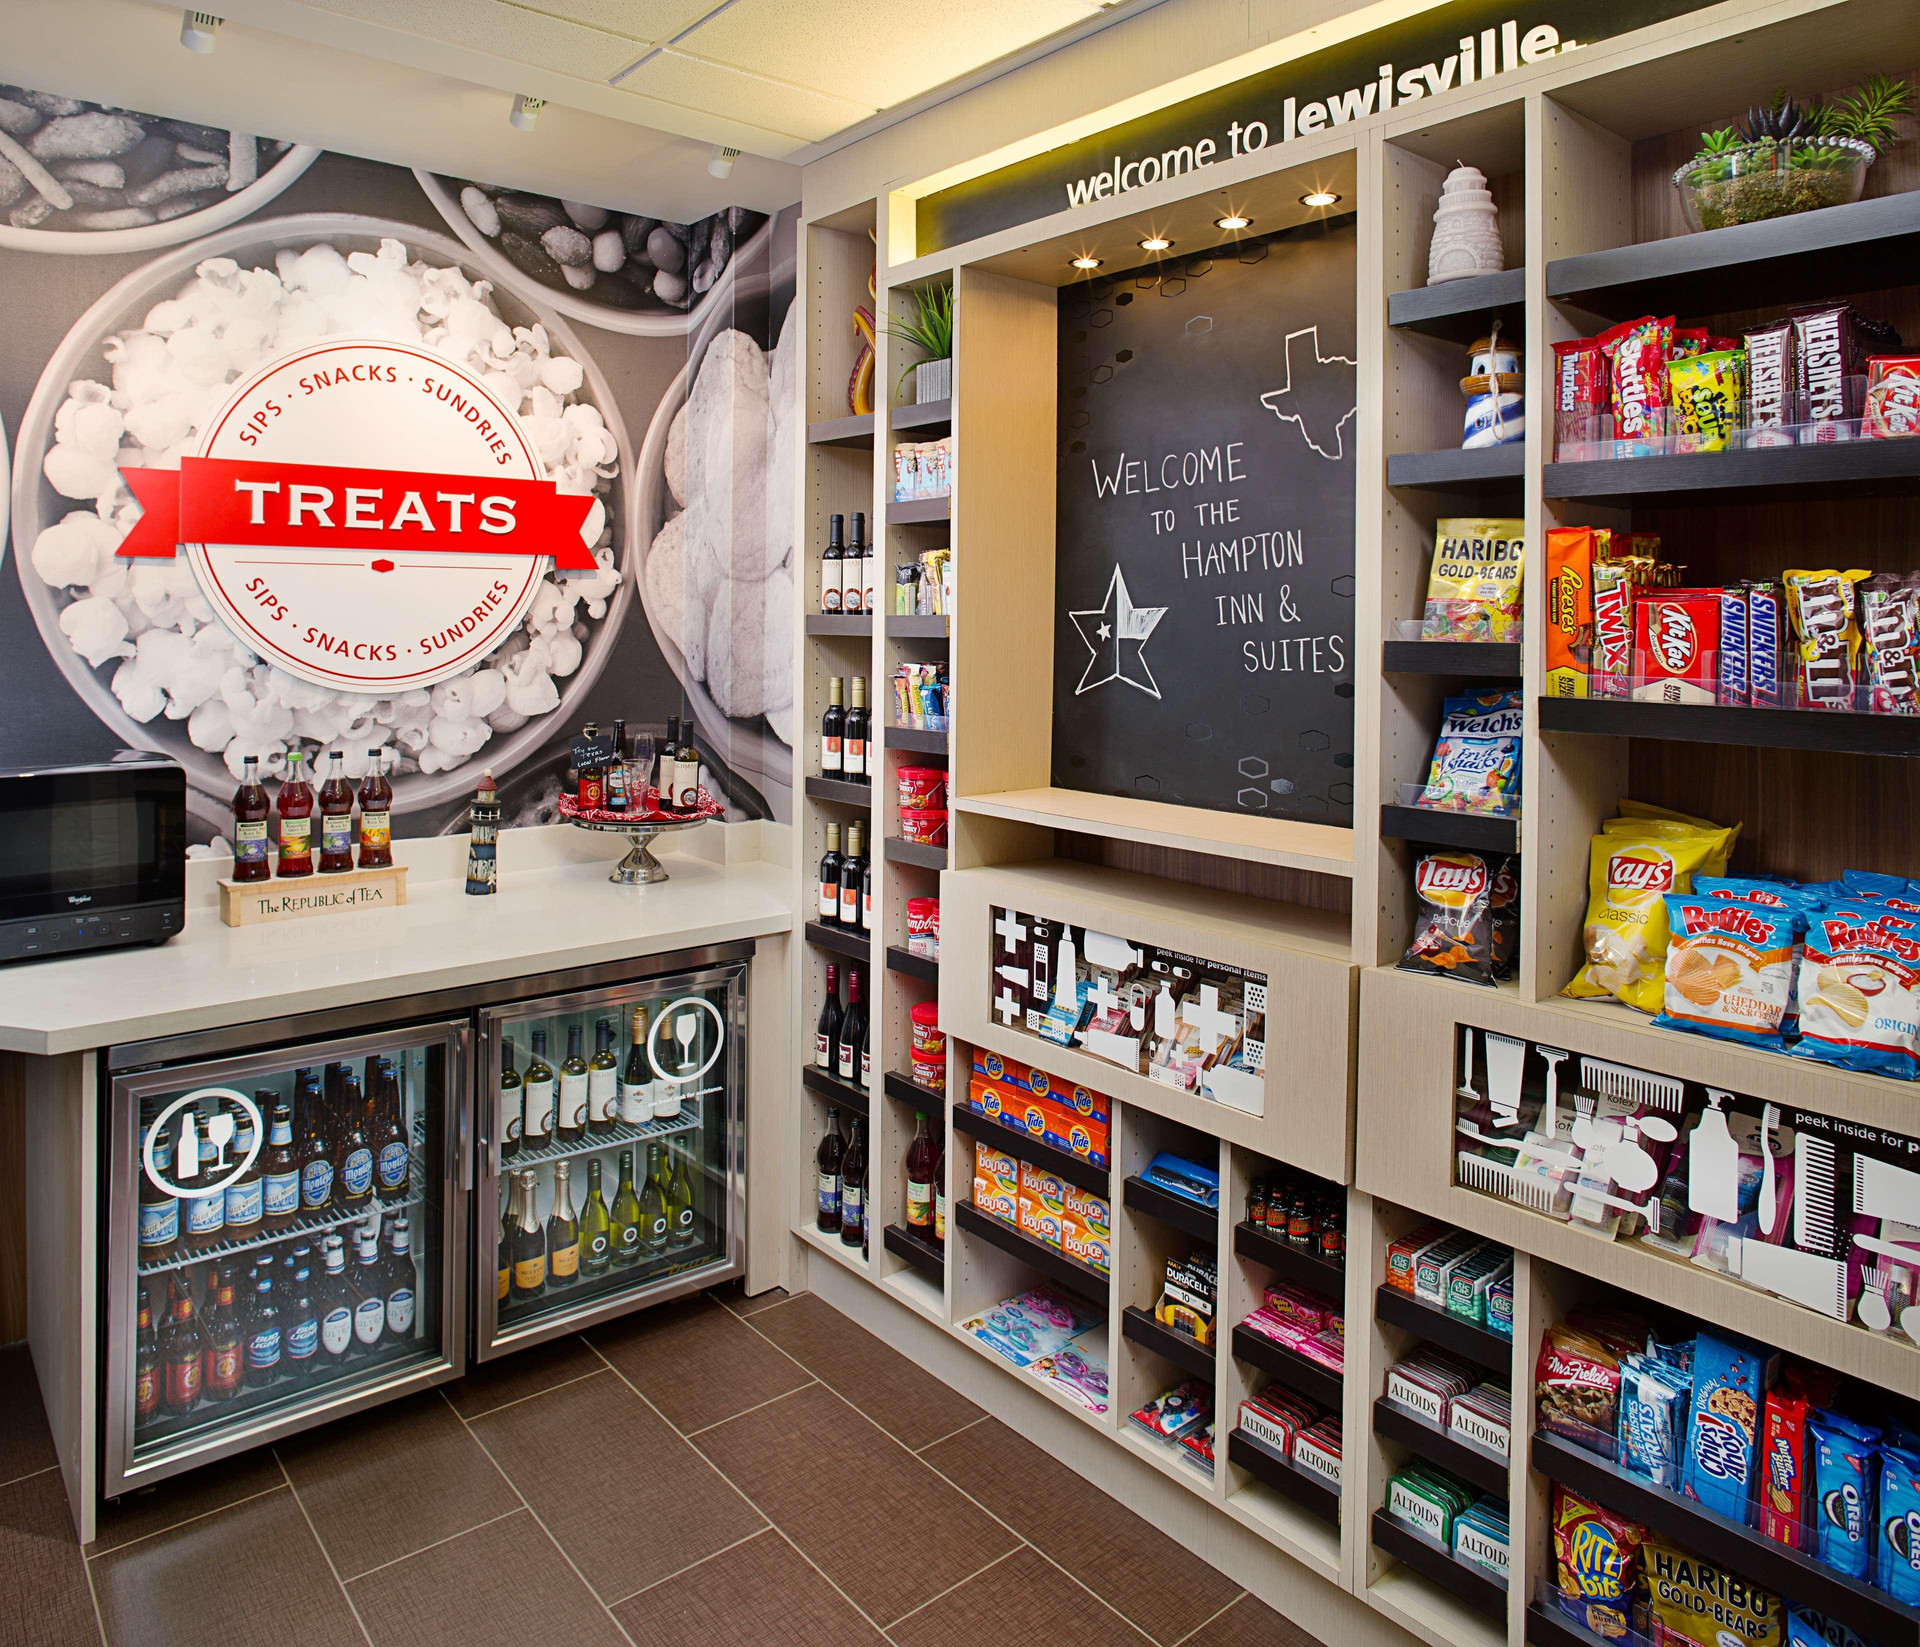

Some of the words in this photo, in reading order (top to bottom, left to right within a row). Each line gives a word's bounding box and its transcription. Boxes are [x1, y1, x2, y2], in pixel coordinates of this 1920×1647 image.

[1066, 136, 1216, 210] welcome
[1227, 119, 1268, 157] to
[1561, 351, 1579, 413] Twizzlers
[1751, 335, 1783, 428] HERSHEY'S
[1805, 313, 1844, 420] HERSHEY'S
[1620, 338, 1647, 435] Skittles
[238, 399, 283, 446] SIPS
[298, 364, 398, 397] SNACKS
[421, 377, 513, 466] SUNDRIES
[1692, 385, 1719, 443] SOUR
[1091, 441, 1247, 499] WELCOME
[235, 479, 518, 535] TREATS
[1150, 509, 1176, 535] TO
[1193, 498, 1241, 527] THE
[1182, 528, 1304, 580] HAMPTON
[1441, 538, 1524, 562] HARIBO
[1438, 563, 1518, 580] GOLD-BEARS
[1214, 592, 1264, 626] INN
[1279, 584, 1302, 623] &
[1561, 566, 1584, 636] Reese's
[245, 576, 289, 623] SIPS
[302, 626, 398, 662] SNACKS
[419, 579, 509, 656] SUNDRIES
[1594, 578, 1634, 671] TWIX
[1243, 634, 1346, 674] SUITES
[1722, 596, 1747, 693] SNICKERS
[1750, 594, 1777, 694] SNICKERS
[1449, 712, 1522, 733] Welch's
[1457, 747, 1498, 761] Fruit
[1419, 860, 1484, 893] Lay's
[1610, 856, 1672, 890] Lay's
[257, 898, 280, 915] The
[282, 892, 345, 913] REPUBLIC
[346, 888, 357, 906] of
[358, 888, 382, 903] TEA
[1597, 908, 1650, 926] Classic
[1681, 905, 1776, 946] Ruffles
[1822, 919, 1920, 962] Ruffles
[1175, 951, 1194, 963] inside
[1195, 955, 1206, 966] for
[1207, 959, 1242, 976] personal
[1722, 993, 1783, 1018] CHEDDAR
[1722, 1005, 1729, 1013] &
[986, 1056, 1002, 1072] Tide
[1031, 1073, 1048, 1089] Tide
[984, 1094, 1000, 1110] Tide
[1074, 1092, 1092, 1108] Tide
[1026, 1112, 1044, 1128] Tide
[1795, 1111, 1830, 1130] peek
[1833, 1120, 1876, 1142] inside
[1880, 1131, 1904, 1148] for
[1071, 1132, 1089, 1148] Tide
[978, 1153, 1011, 1176] bounce
[1023, 1173, 1057, 1196] bounce
[977, 1191, 1010, 1214] bounce
[1067, 1194, 1103, 1218] bounce
[1022, 1211, 1055, 1236] bounce
[1266, 1225, 1286, 1234] EXTRA
[1289, 1235, 1309, 1243] EXTRA
[1065, 1234, 1103, 1260] bounce
[1166, 1266, 1208, 1296] DURACELL
[1181, 1292, 1190, 1303] 10
[250, 1337, 281, 1350] LIGHT
[255, 1331, 280, 1344] BUD
[290, 1328, 319, 1341] LIGHT
[295, 1321, 318, 1335] BUD
[1390, 1381, 1437, 1416] ALTOIDS
[1695, 1377, 1721, 1410] ORIGINAL
[1243, 1414, 1281, 1447] ALTOIDS
[1455, 1413, 1506, 1449] ALTOIDS
[1639, 1402, 1661, 1470] TREATS
[1298, 1446, 1340, 1480] ALTOIDS
[1770, 1452, 1790, 1490] Butter
[1775, 1438, 1794, 1477] Nutter
[1393, 1491, 1440, 1528] ALTOIDS
[1841, 1482, 1861, 1543] OREO
[1571, 1523, 1620, 1579] RITZ
[1578, 1573, 1623, 1599] bits
[1654, 1551, 1769, 1619] HARIBO
[1657, 1579, 1768, 1640] GOLD-BEARS
